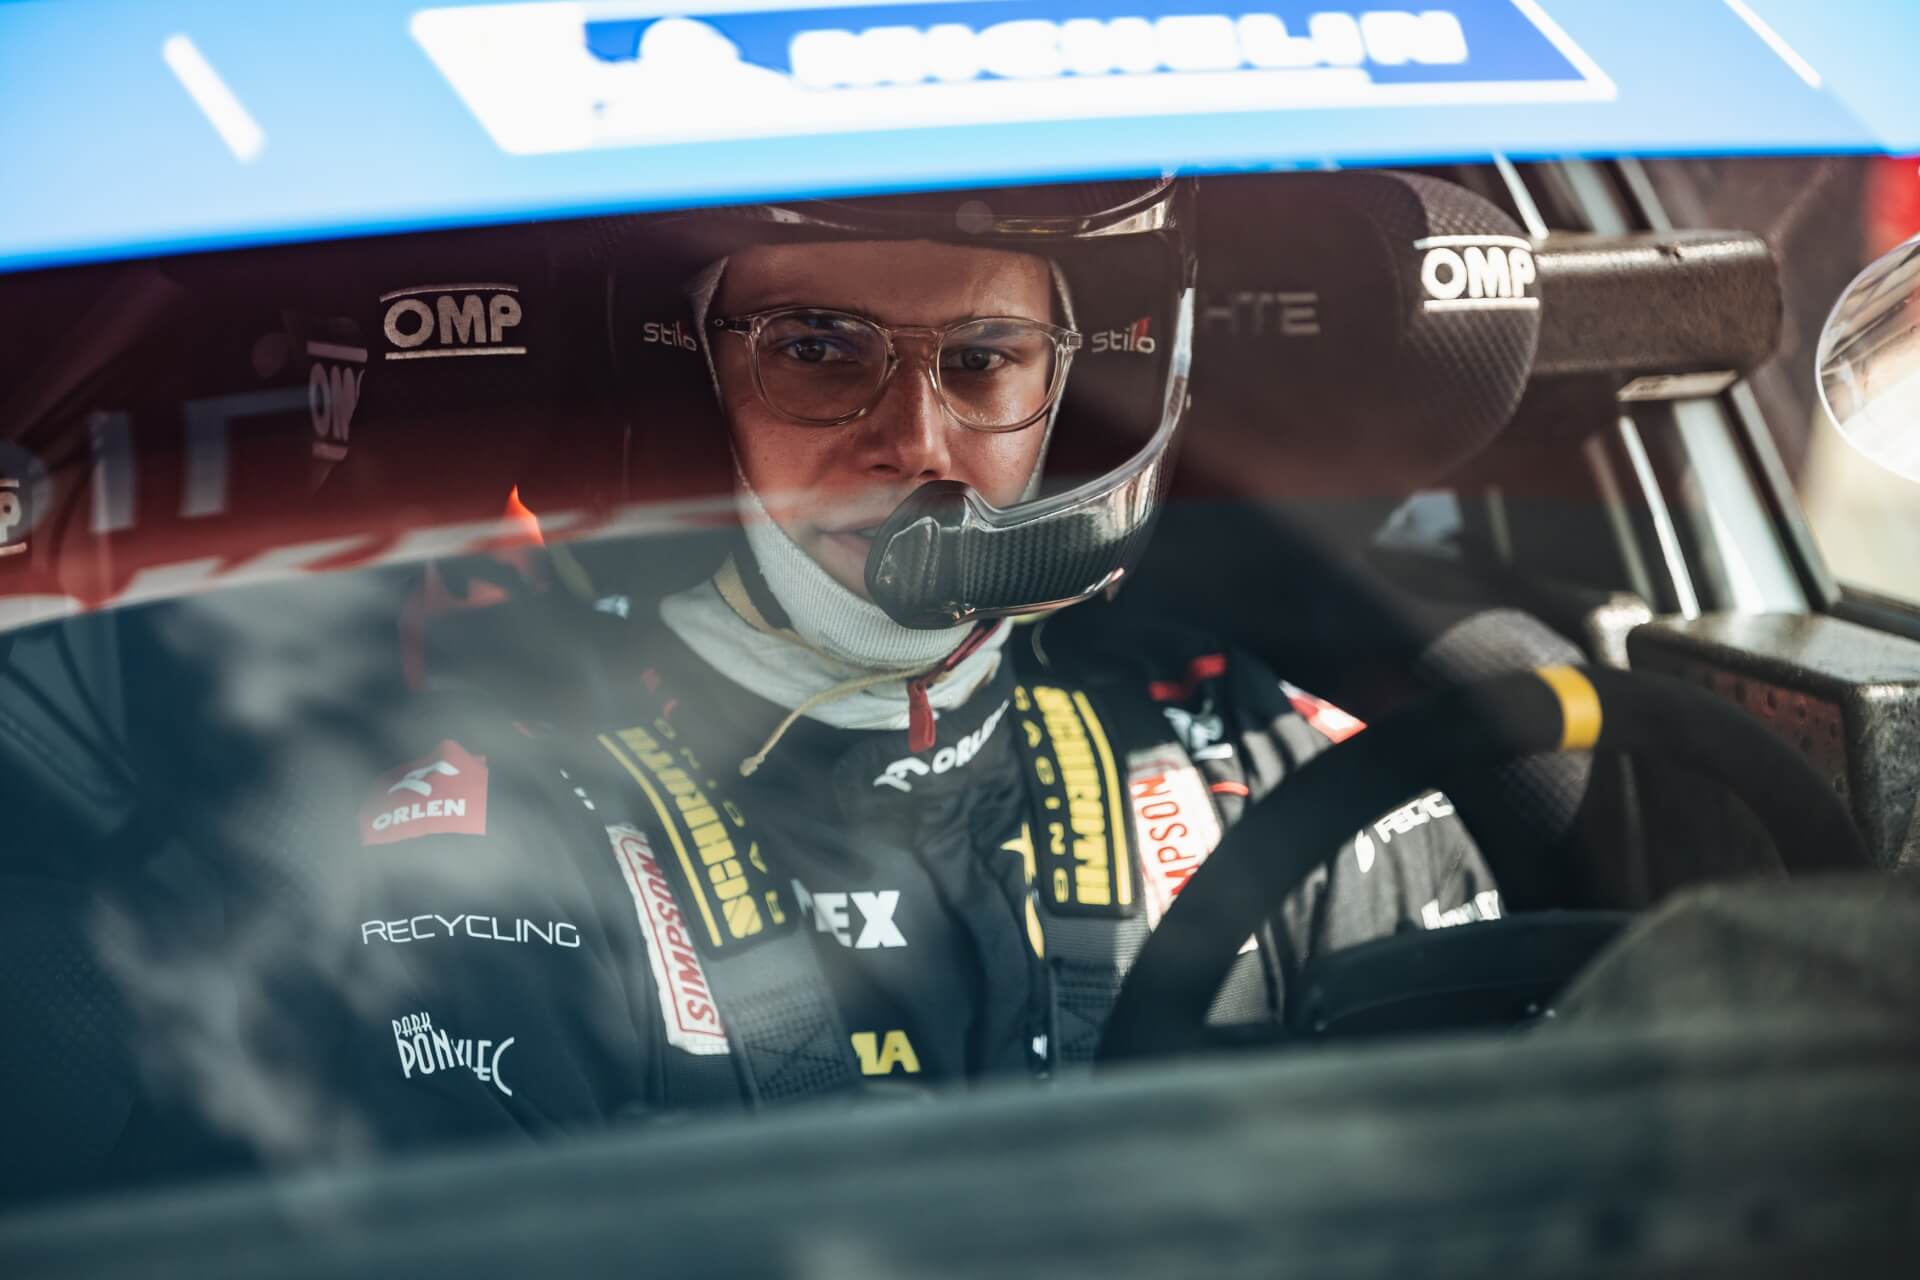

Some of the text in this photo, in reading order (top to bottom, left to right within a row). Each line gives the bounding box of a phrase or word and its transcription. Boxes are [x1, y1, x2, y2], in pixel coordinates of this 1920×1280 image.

[1421, 246, 1536, 300] OMP
[383, 294, 522, 348] OMP
[308, 362, 366, 440] OM
[371, 798, 467, 831] ORLEN
[360, 914, 581, 948] RECYCLING
[636, 850, 716, 1026] SIMPSON
